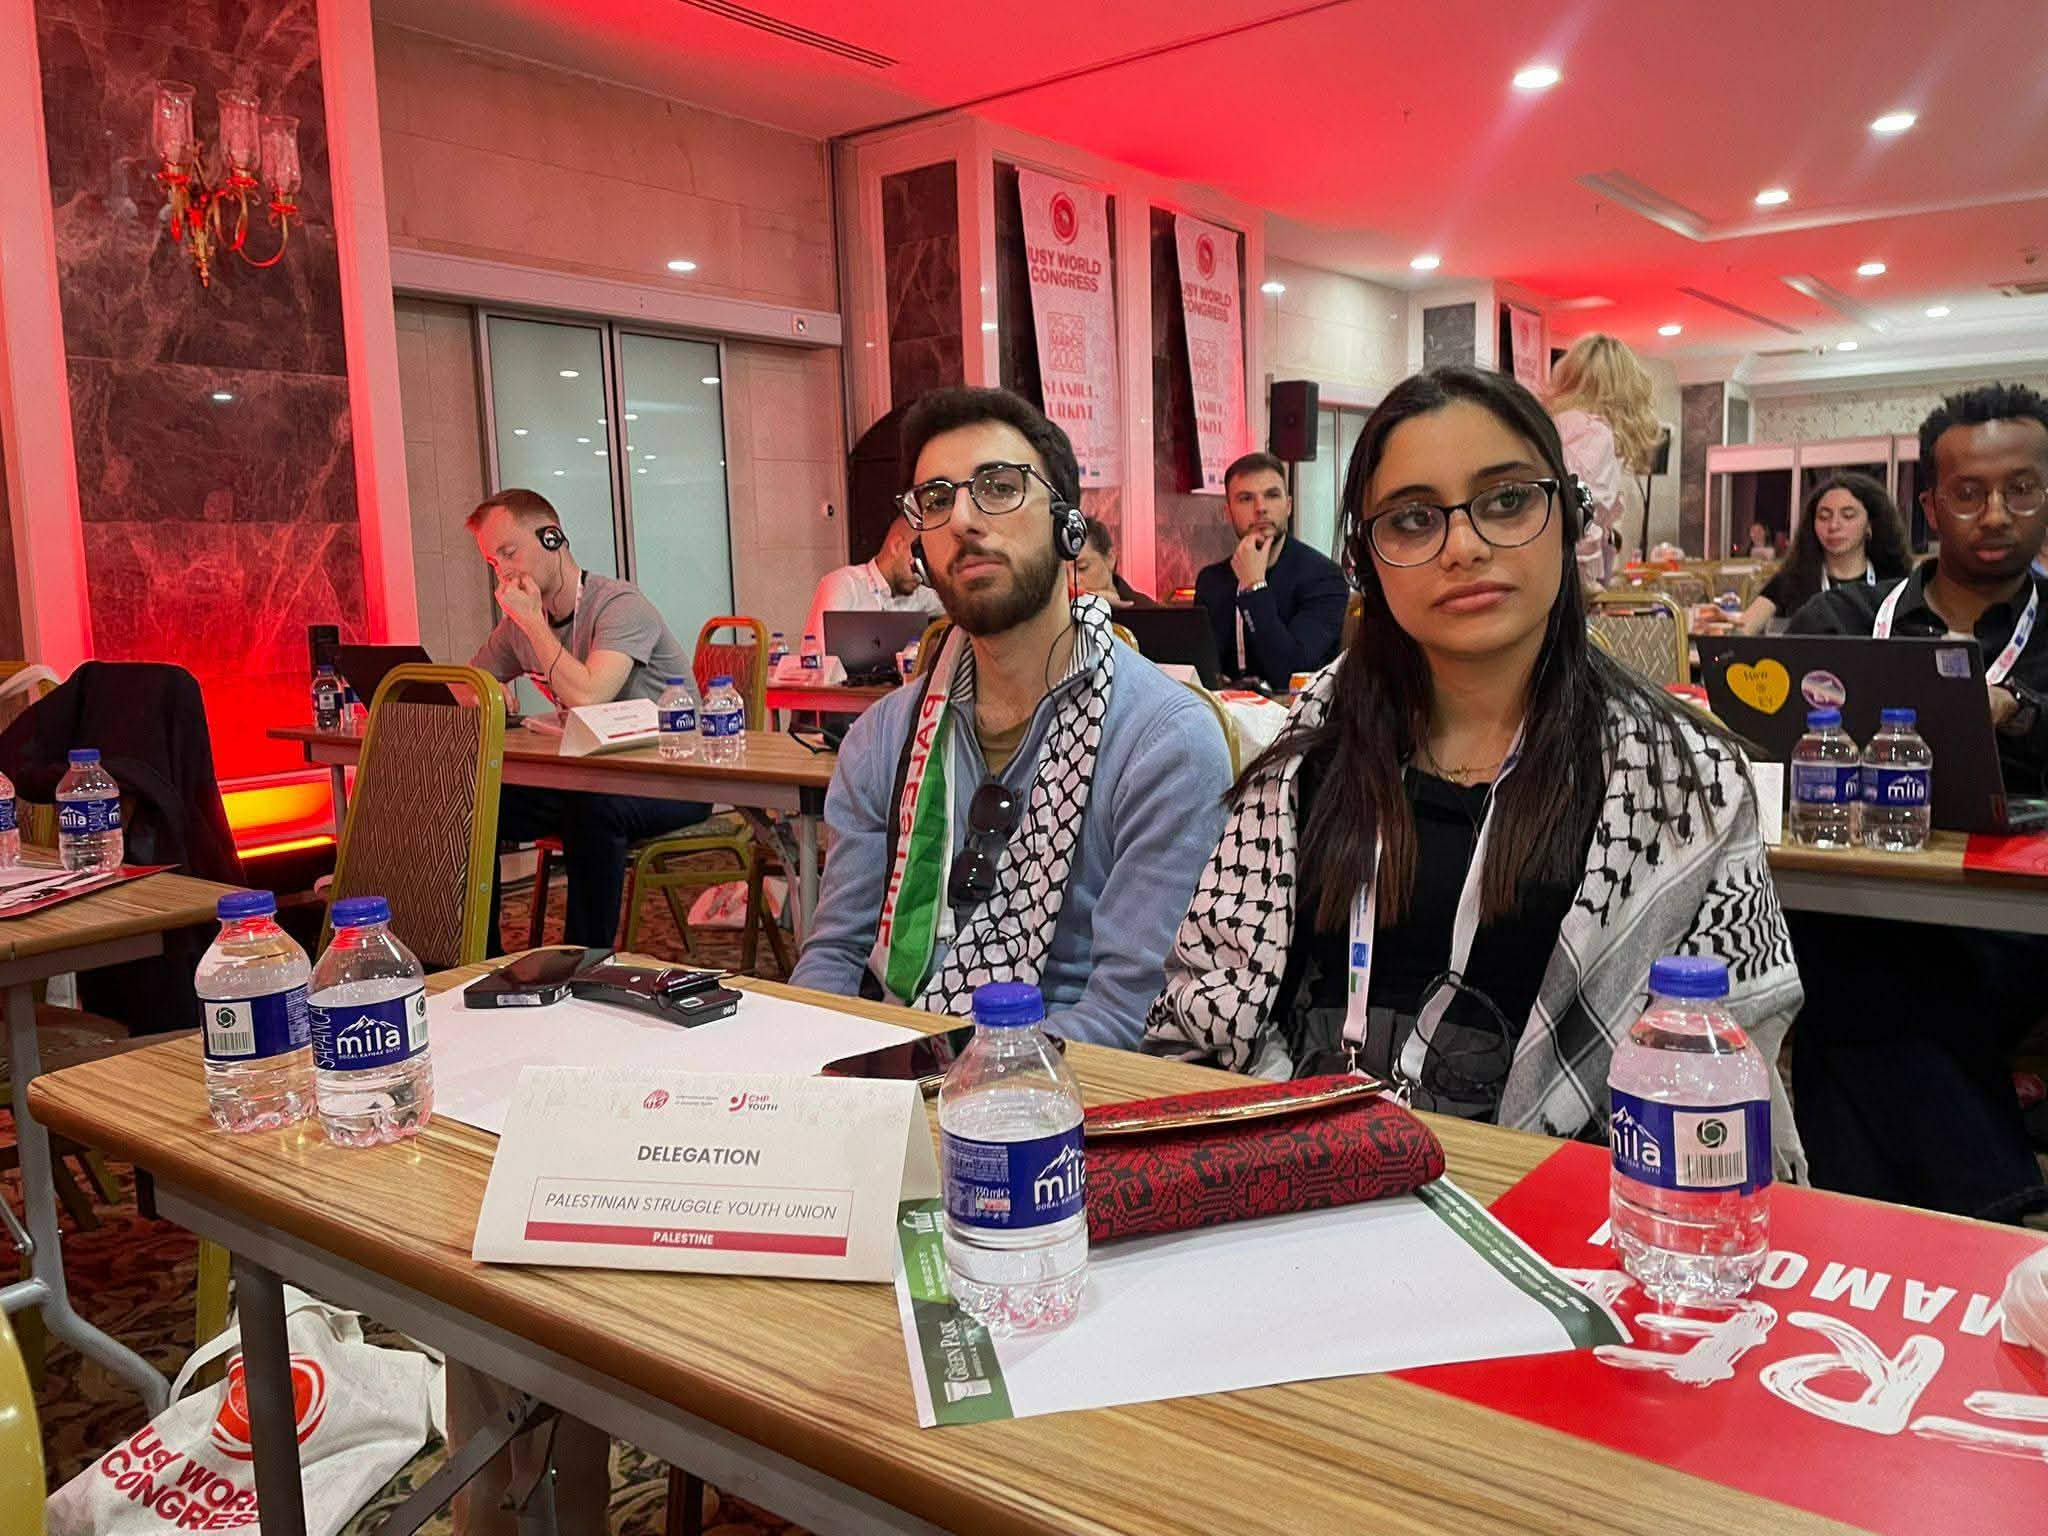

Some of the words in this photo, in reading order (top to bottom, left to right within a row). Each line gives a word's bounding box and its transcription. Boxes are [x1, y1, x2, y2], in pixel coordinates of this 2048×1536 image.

[1058, 253, 1101, 276] WORLD
[1031, 266, 1099, 293] CONGRESS
[1199, 286, 1232, 308] WORLD
[1887, 783, 1925, 799] mila
[310, 1007, 336, 1069] SAPANCA
[337, 1027, 401, 1054] mila
[748, 1103, 778, 1112] YOUTH
[637, 1144, 761, 1167] DELEGATION
[545, 1192, 639, 1213] PALESTINIAN
[643, 1196, 722, 1216] STRUGGLE
[727, 1200, 781, 1218] YOUTH
[784, 1203, 838, 1221] UNION
[652, 1231, 715, 1246] PALESTINE
[102, 1450, 260, 1530] CONGRES
[176, 1459, 258, 1511] WOR
